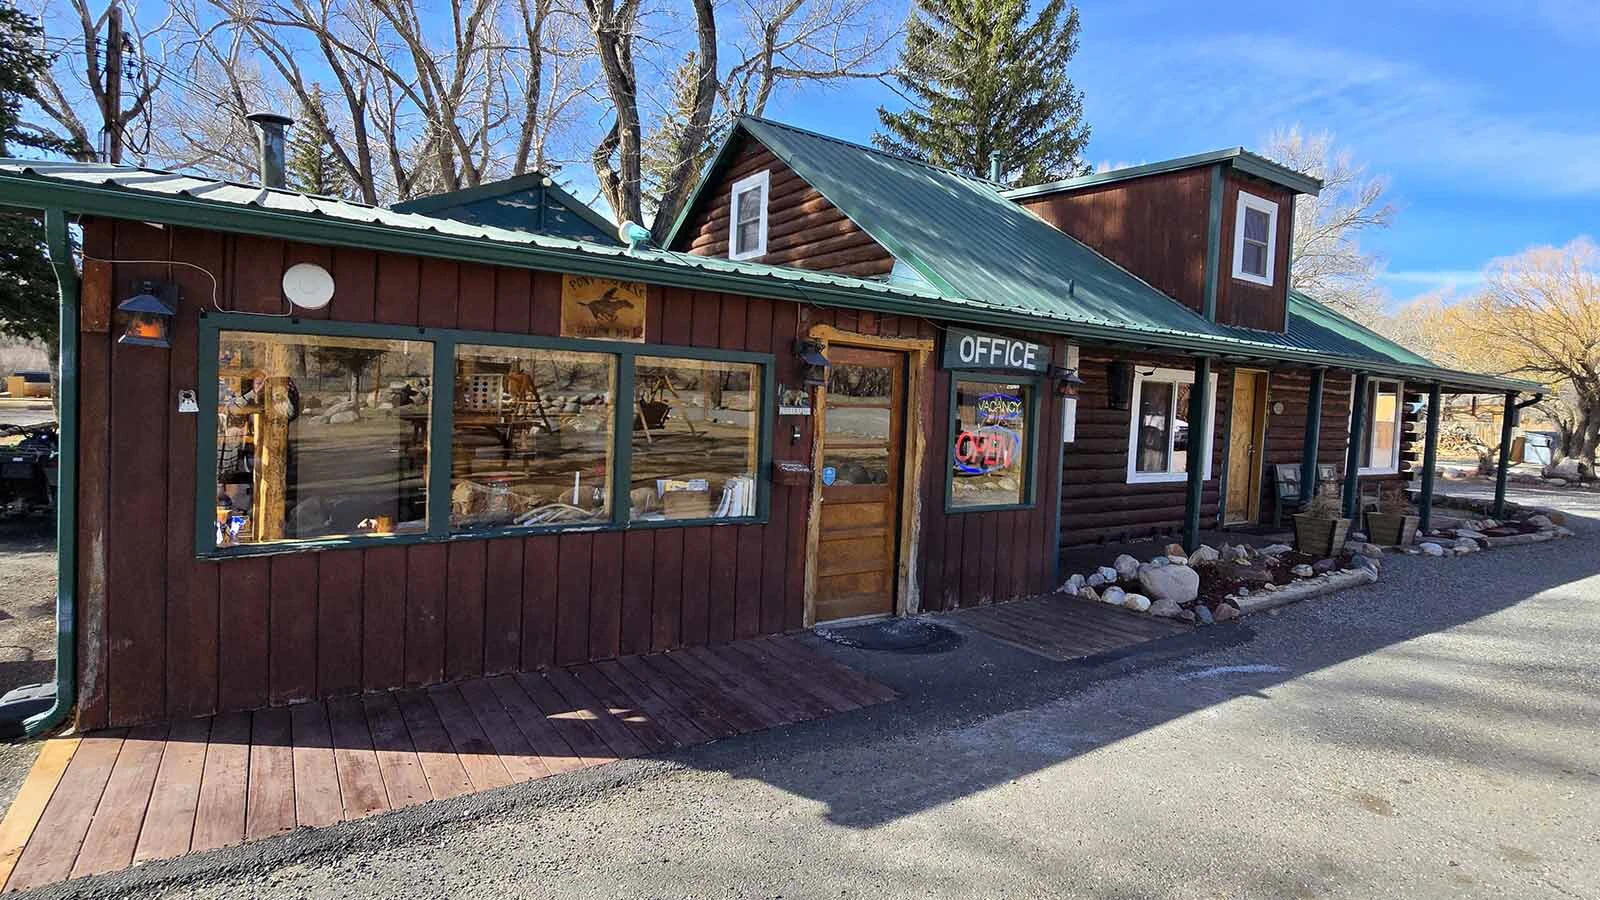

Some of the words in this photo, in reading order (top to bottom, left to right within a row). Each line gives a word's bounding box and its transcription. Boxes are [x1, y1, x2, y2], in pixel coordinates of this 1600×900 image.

[959, 335, 1039, 370] OFFICE
[978, 399, 1023, 413] VACANCY
[956, 431, 1013, 468] OPEN
